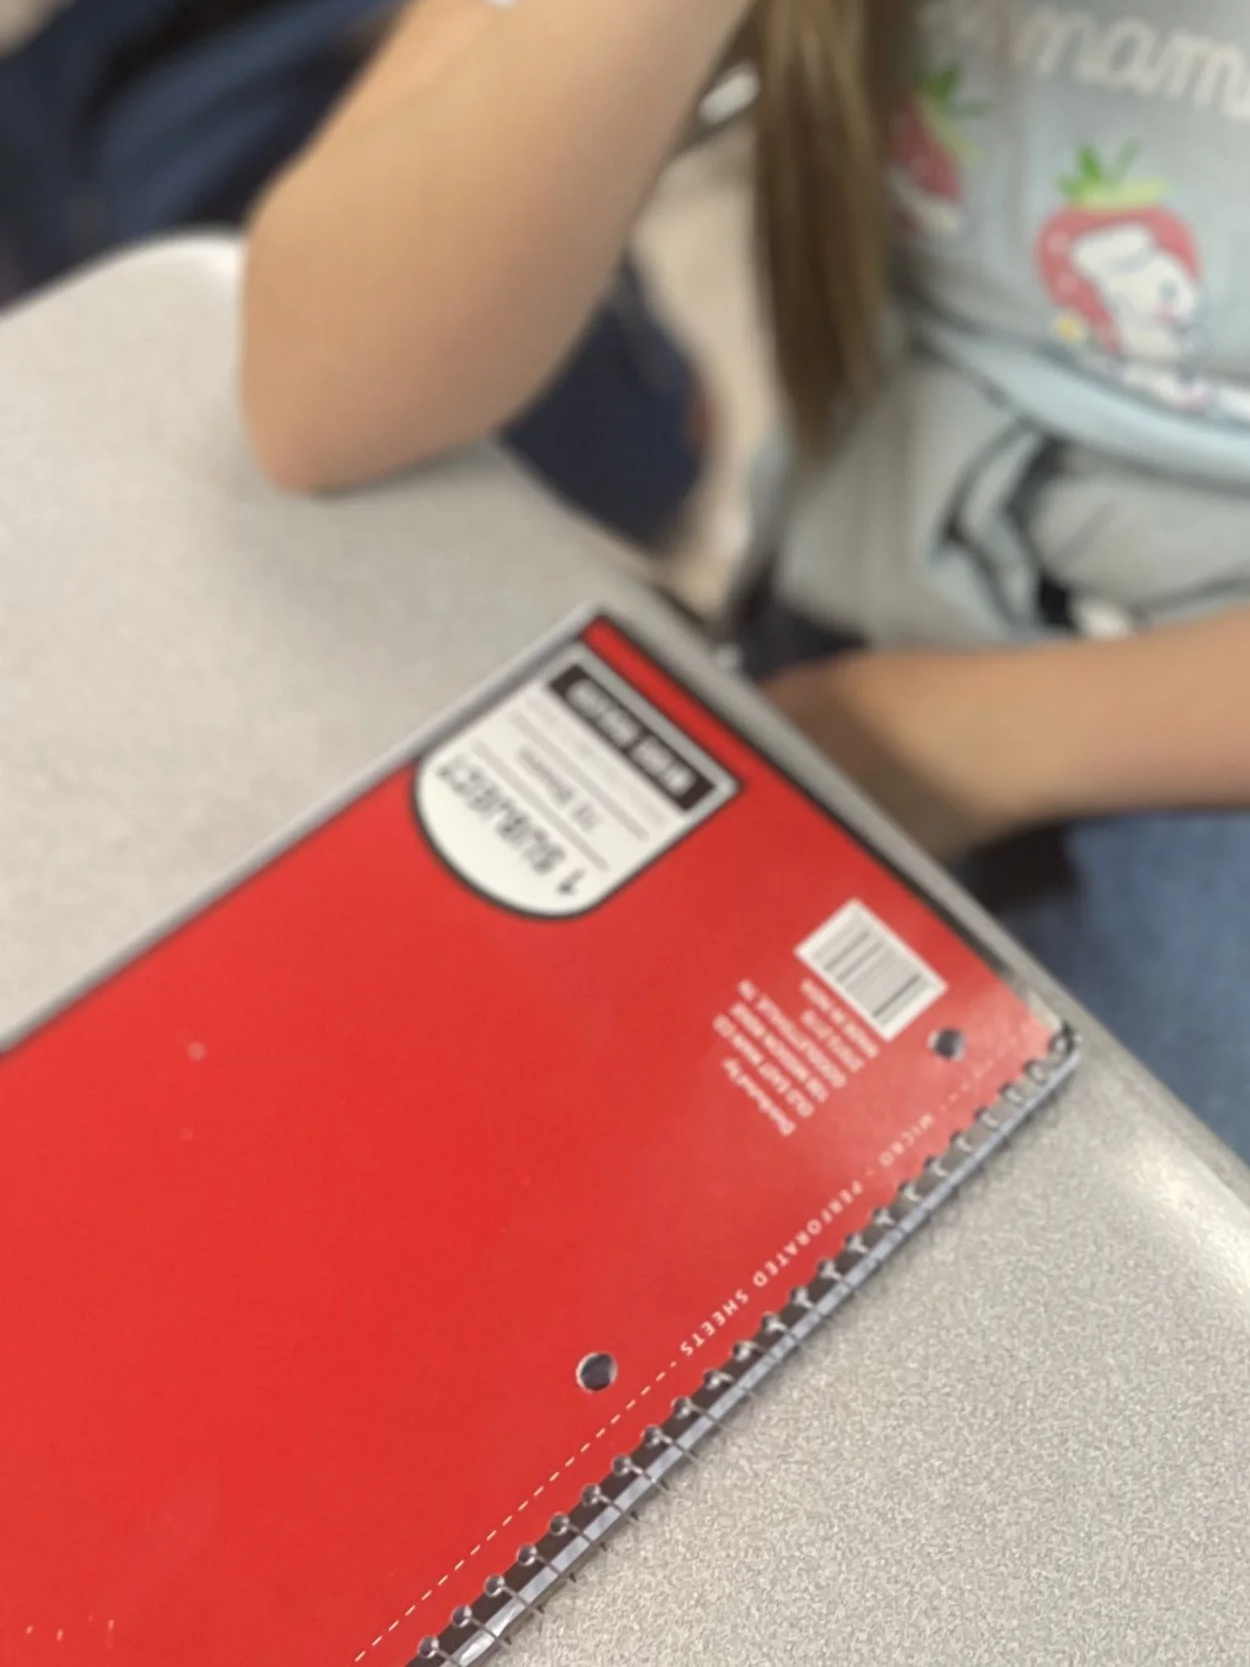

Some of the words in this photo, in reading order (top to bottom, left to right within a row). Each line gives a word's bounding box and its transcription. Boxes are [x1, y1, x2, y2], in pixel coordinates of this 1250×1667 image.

[435, 753, 567, 875] SUBJECT
[556, 869, 586, 895] 1
[878, 1113, 935, 1167] MICRO
[752, 1180, 863, 1287] PERFORATED
[680, 1289, 750, 1357] SHEETS
